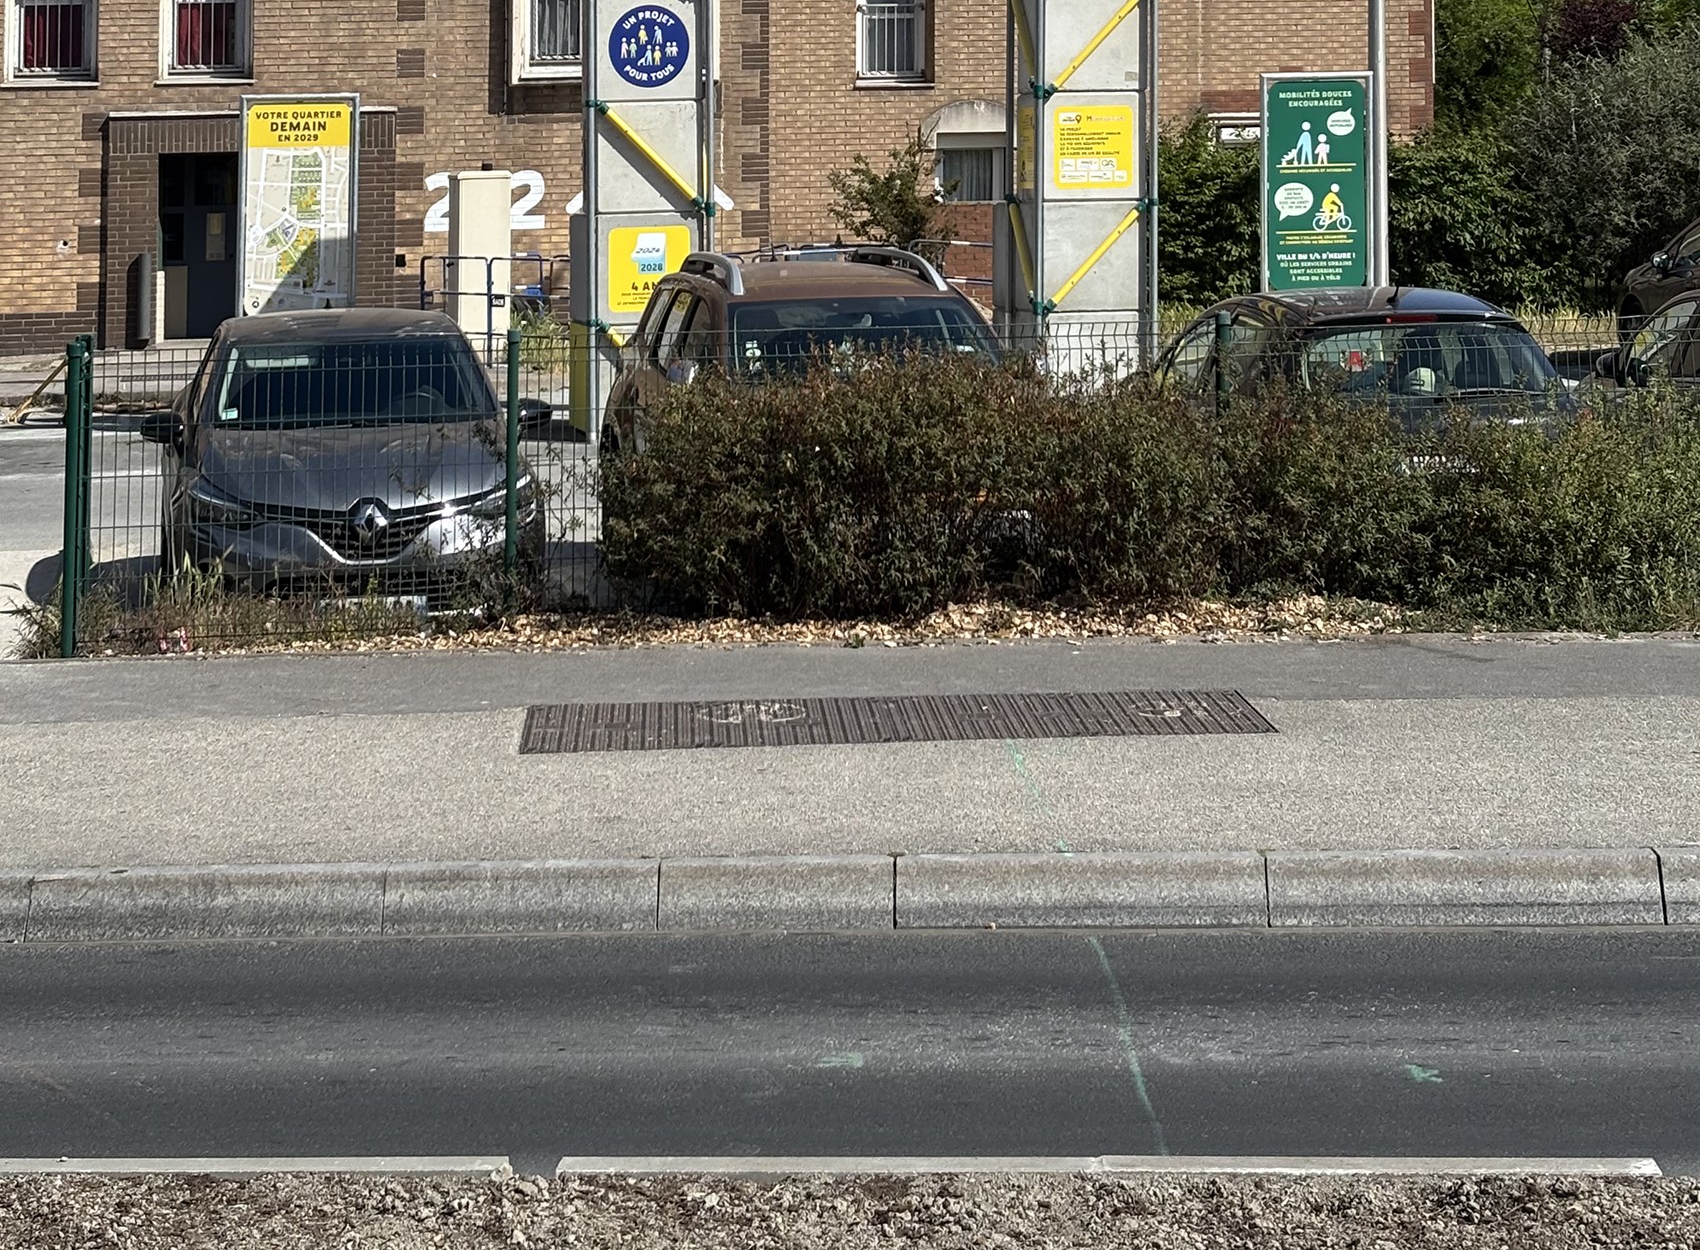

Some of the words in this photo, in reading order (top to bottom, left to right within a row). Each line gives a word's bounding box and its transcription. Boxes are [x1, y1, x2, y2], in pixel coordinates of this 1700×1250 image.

[622, 16, 637, 29] UN
[638, 10, 675, 27] PROJET
[624, 65, 648, 81] POUR
[650, 63, 675, 81] TOUS
[1279, 89, 1320, 99] MOBILITÉS
[1322, 90, 1353, 98] DOUCES
[1288, 98, 1343, 108] ENCOURAGÉES
[255, 111, 288, 120] VOTRE
[291, 111, 342, 120] QUARTIER
[270, 121, 327, 132] DEMAIN
[278, 134, 291, 142] EN
[294, 133, 319, 142] 2029
[1276, 253, 1297, 261] VILLE
[640, 262, 664, 272] 2028
[631, 282, 638, 292] 4
